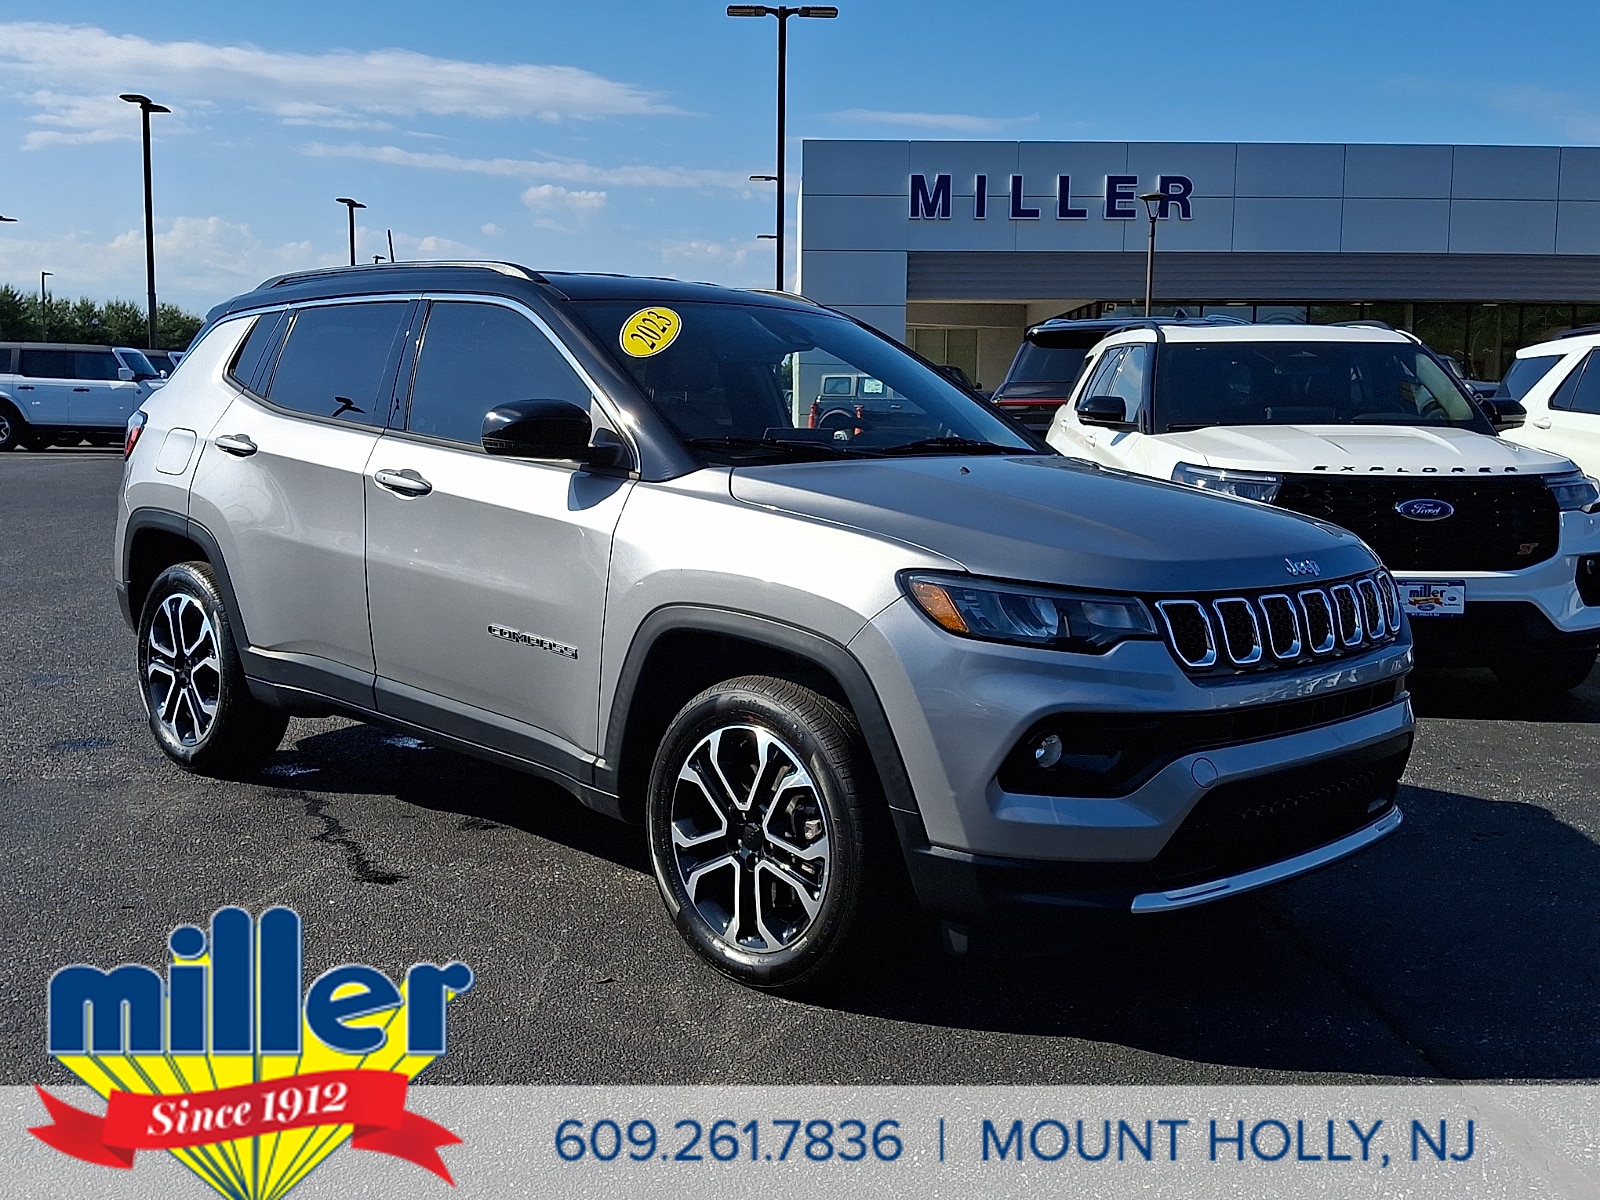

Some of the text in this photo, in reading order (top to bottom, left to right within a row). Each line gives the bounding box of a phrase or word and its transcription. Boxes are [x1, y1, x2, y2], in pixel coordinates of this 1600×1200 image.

[908, 173, 1195, 220] MILLER
[630, 310, 672, 350] 2023
[1312, 464, 1519, 474] EXPLORER
[1284, 557, 1321, 577] Jeep
[1408, 585, 1447, 598] miller
[487, 623, 578, 660] COMPASS
